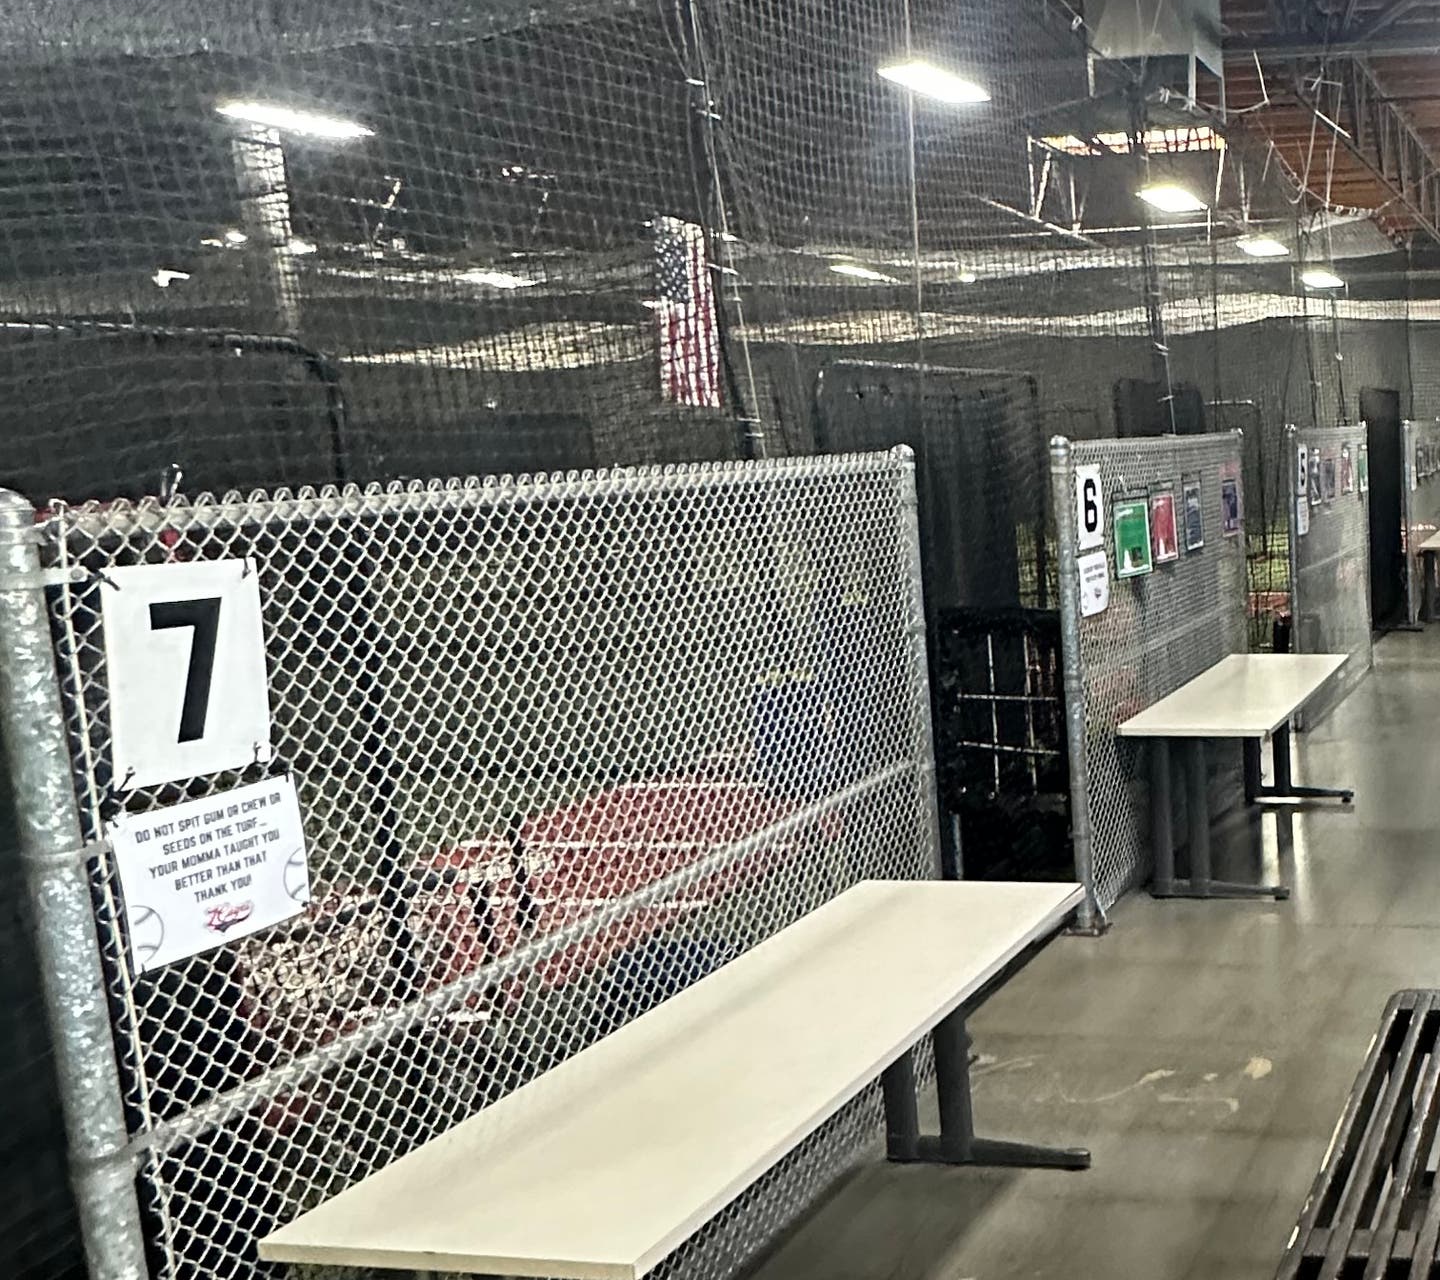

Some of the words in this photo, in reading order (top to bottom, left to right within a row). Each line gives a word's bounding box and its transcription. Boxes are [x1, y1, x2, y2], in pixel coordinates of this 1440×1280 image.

[1084, 478, 1098, 533] 6
[149, 597, 222, 743] 7
[135, 828, 150, 843] DO
[154, 822, 175, 839] NOT
[178, 815, 200, 832] SPIT
[203, 808, 225, 825] GUM
[227, 804, 239, 818] OR
[162, 836, 196, 856] SEEDS
[199, 831, 213, 846] ON
[215, 825, 233, 840] THE
[149, 859, 179, 879] YOUR
[181, 849, 221, 869] MOMMA
[223, 835, 259, 856] TAUGHT
[261, 828, 280, 845] YOU
[174, 868, 213, 891] BETTER
[215, 859, 241, 877] THAN
[243, 851, 267, 868] THAT
[194, 883, 228, 903] THANK
